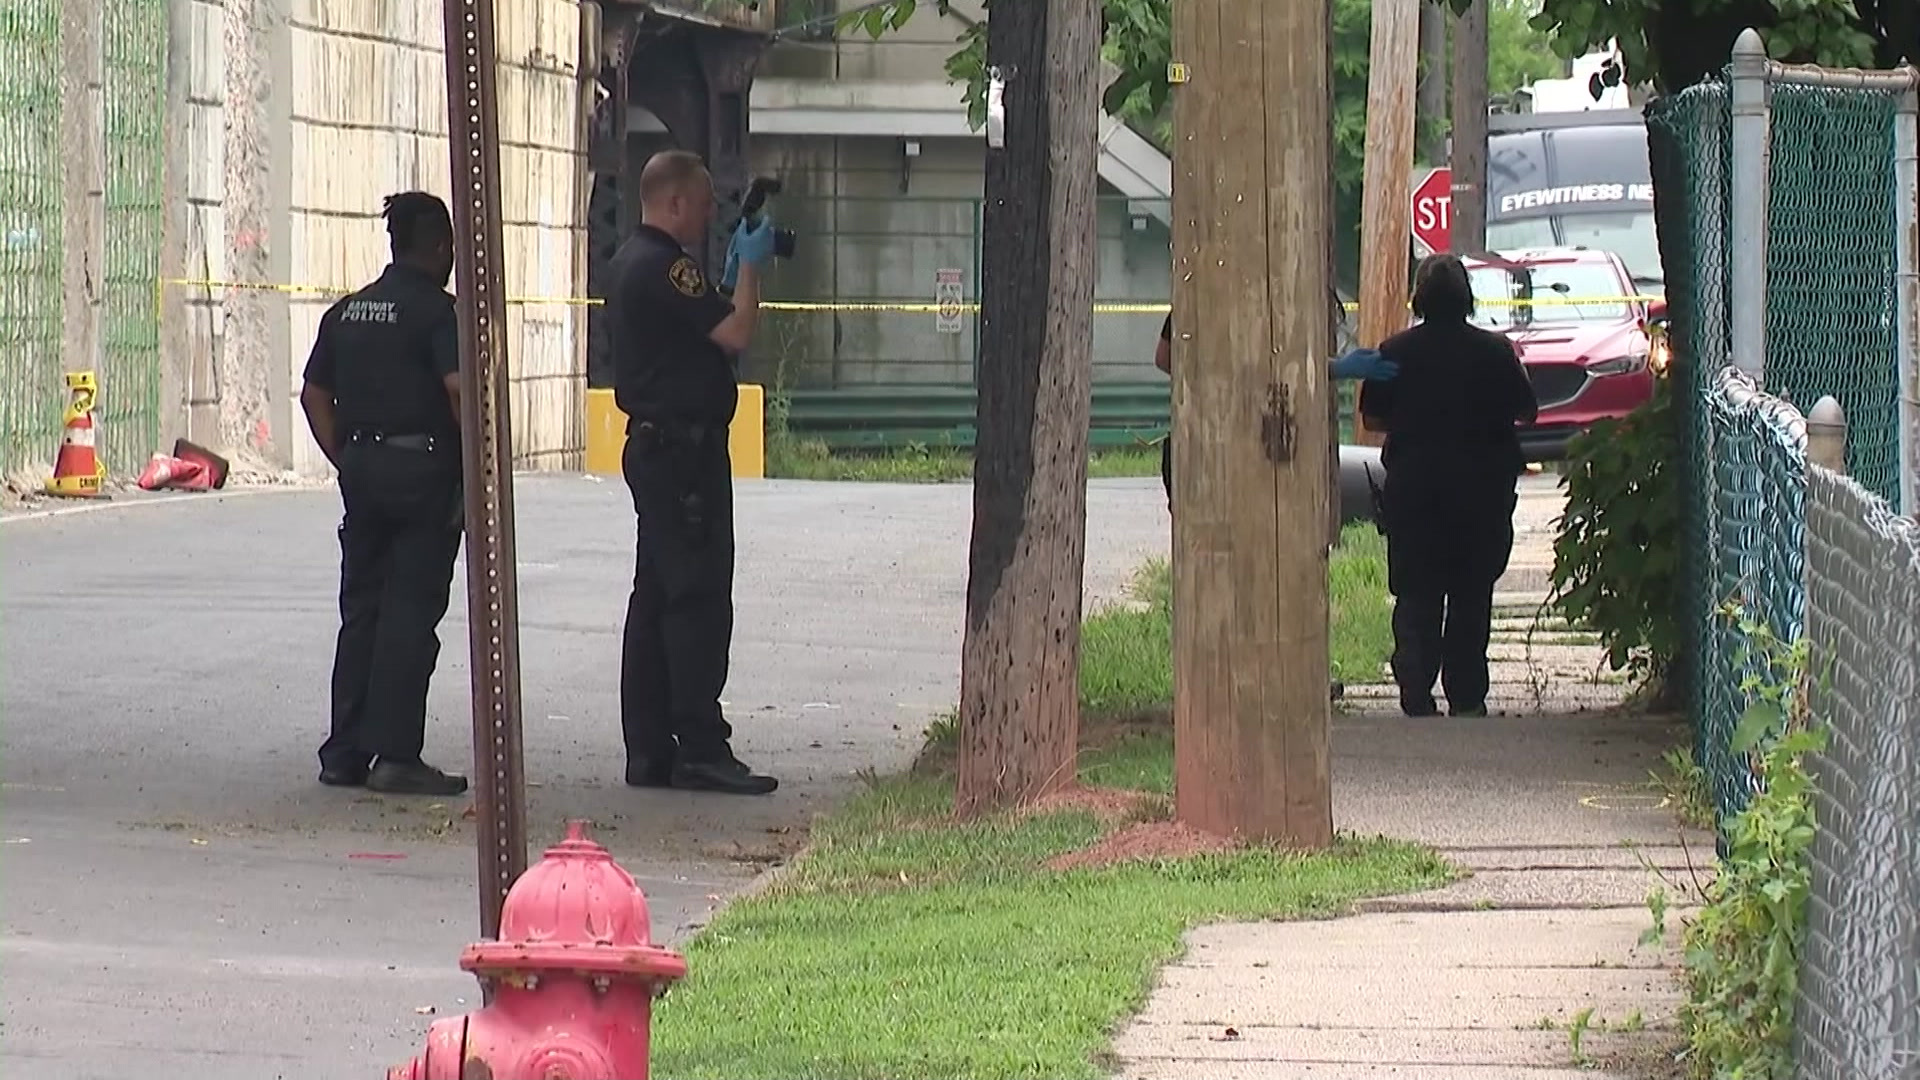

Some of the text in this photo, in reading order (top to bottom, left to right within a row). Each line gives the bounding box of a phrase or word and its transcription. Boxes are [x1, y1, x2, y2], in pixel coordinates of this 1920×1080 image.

[1501, 183, 1655, 212] EYEWITNESS NE
[1418, 196, 1451, 231] ST
[341, 310, 397, 322] POLICE
